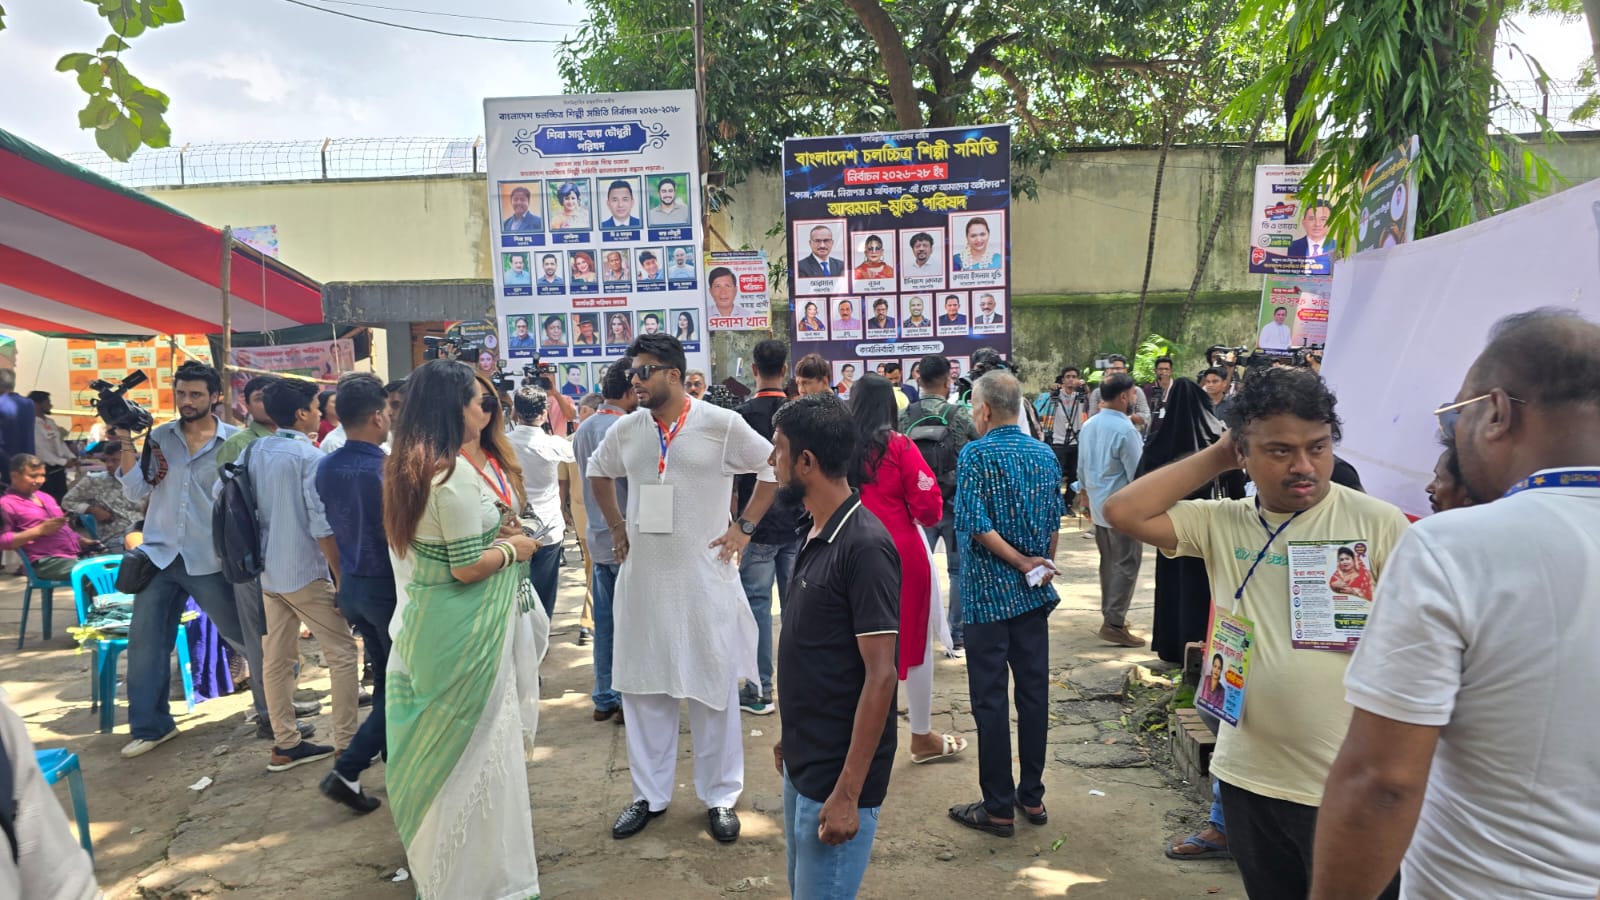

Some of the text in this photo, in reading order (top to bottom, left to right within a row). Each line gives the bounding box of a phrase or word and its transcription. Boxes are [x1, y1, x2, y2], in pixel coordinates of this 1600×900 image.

[498, 111, 533, 120] বাংলাদেশ
[566, 107, 584, 119] শিল্পী
[586, 106, 609, 117] সমিতি
[577, 140, 605, 152] পরিষদ
[794, 137, 999, 168] বাংলাদেশ চলচ্চিত্র শিল্পী সমিতি
[847, 164, 945, 182] নির্বাচন ২০২৬-২৮ ইং
[908, 183, 919, 193] এই
[920, 183, 938, 193] হোক
[939, 182, 969, 191] আমাদের
[826, 191, 968, 218] আরমান-মুক্তি পরিষদ
[709, 316, 768, 328] পলাশ খান
